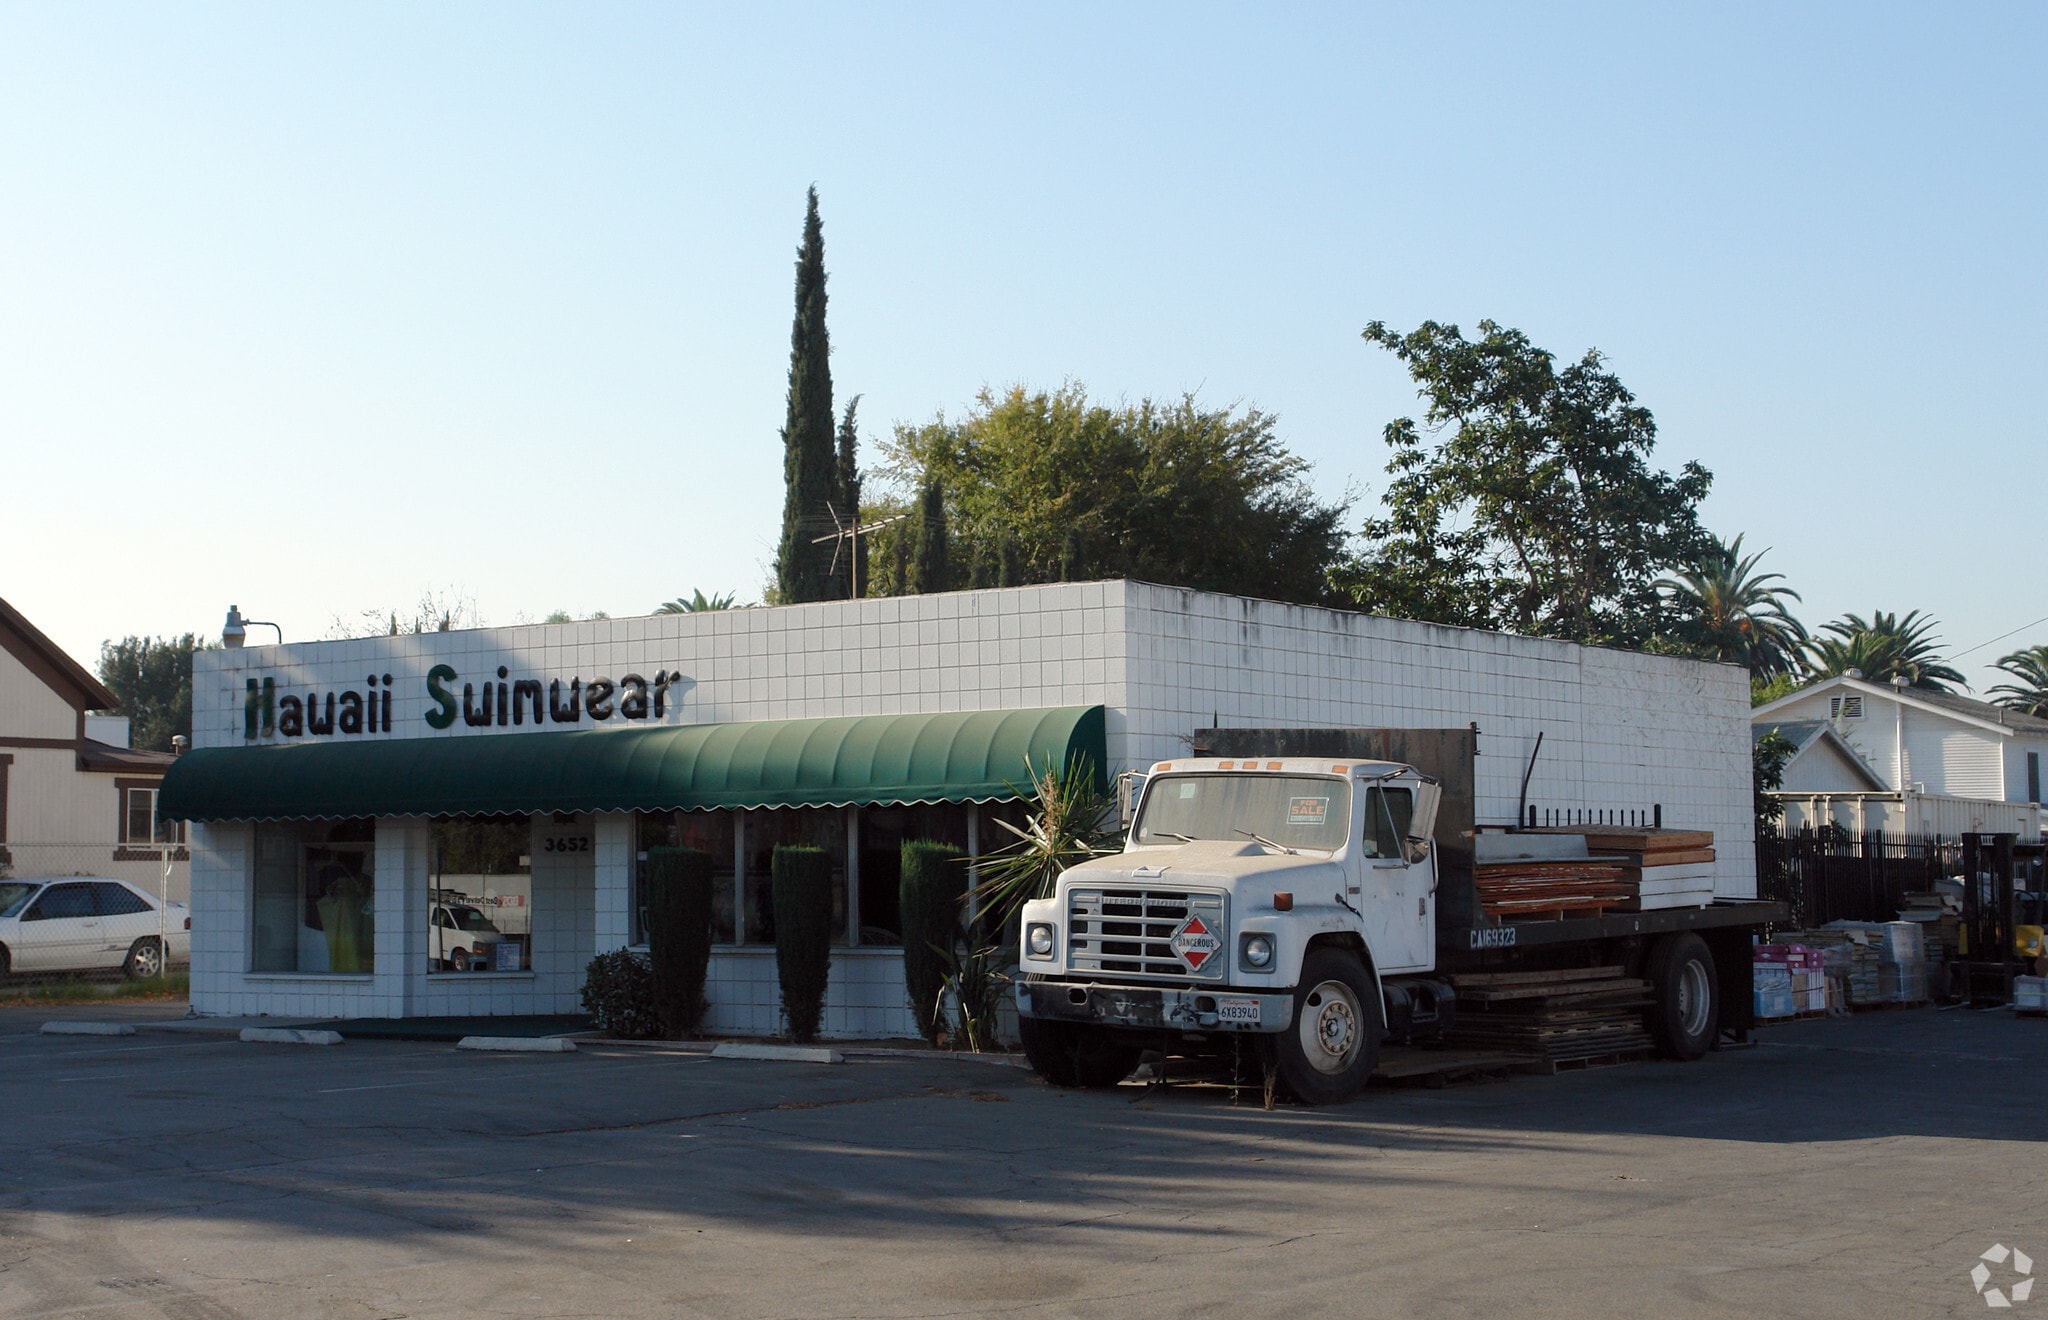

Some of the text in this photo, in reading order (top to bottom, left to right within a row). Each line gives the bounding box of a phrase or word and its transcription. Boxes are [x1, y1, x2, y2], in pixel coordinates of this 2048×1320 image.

[243, 663, 681, 740] Hawaii Swimwear
[1290, 805, 1325, 815] SALE
[544, 837, 589, 852] 3652
[1177, 937, 1215, 948] DANGEROUS
[1221, 1006, 1258, 1019] 6X83940
